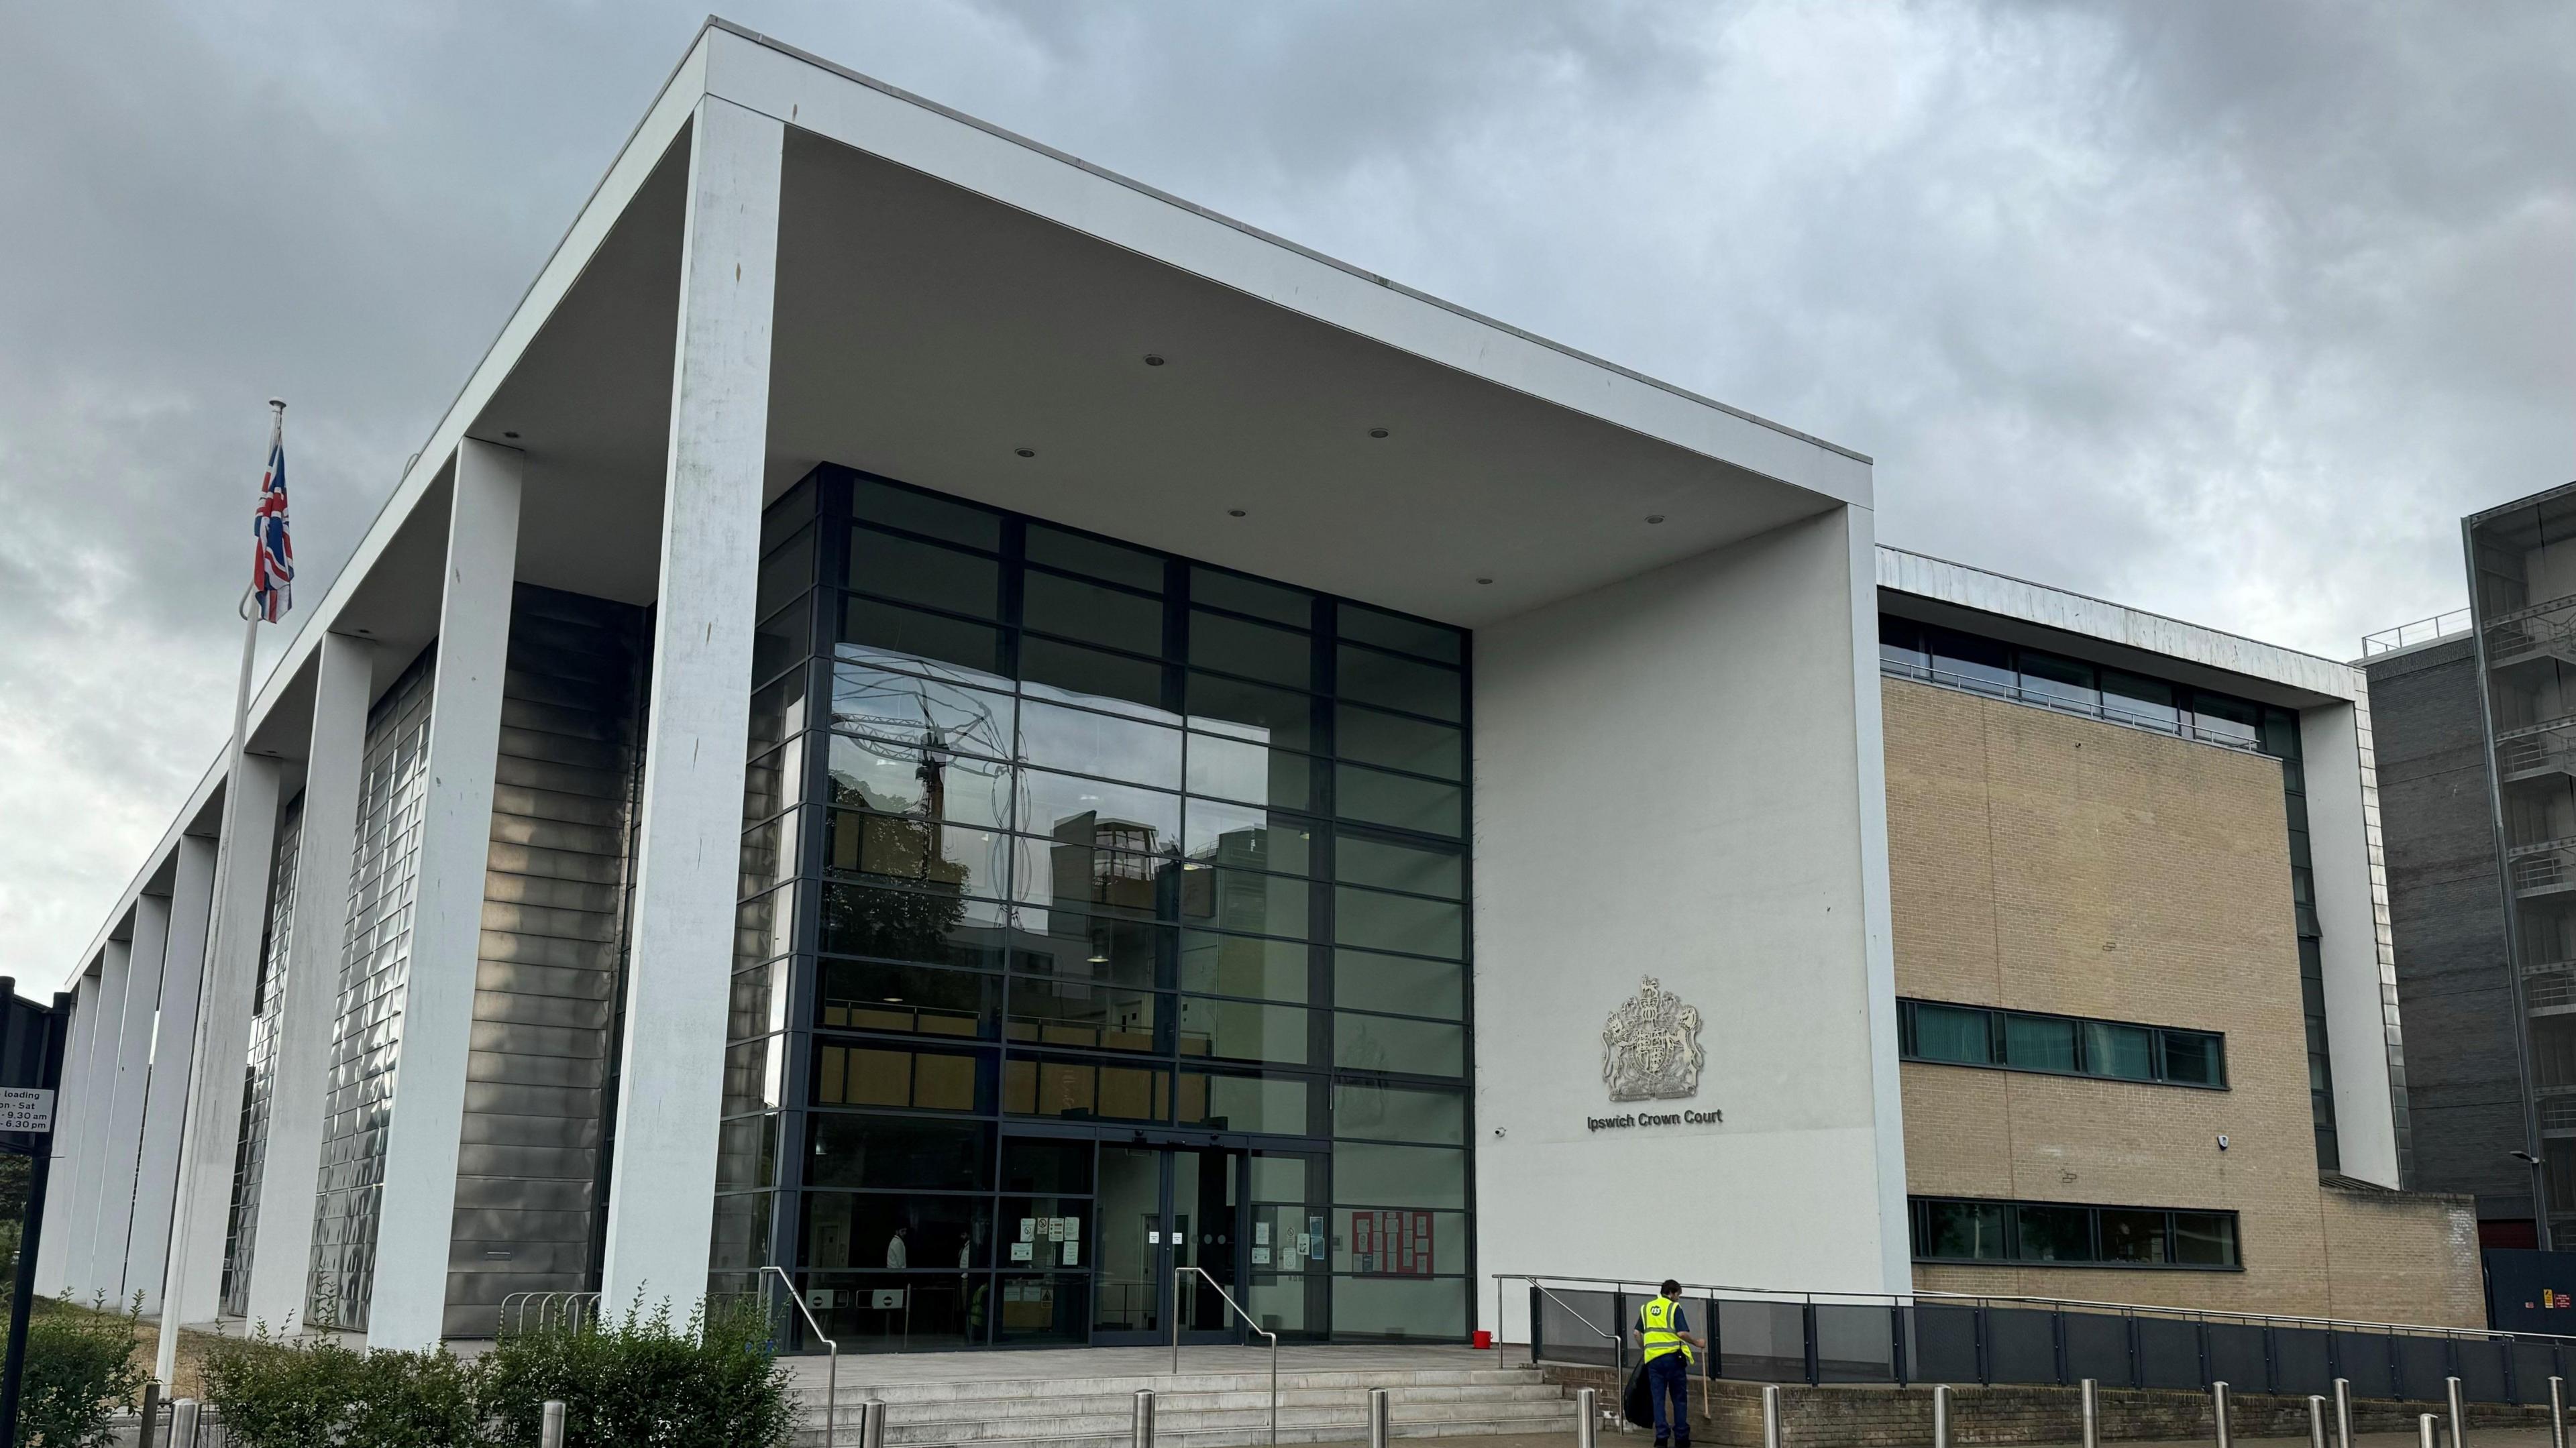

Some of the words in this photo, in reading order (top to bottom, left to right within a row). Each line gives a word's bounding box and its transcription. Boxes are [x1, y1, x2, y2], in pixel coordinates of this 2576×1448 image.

[4, 1090, 40, 1100] loading
[7, 1111, 31, 1119] 9.30
[1587, 1114, 1635, 1131] Ipswich
[1638, 1113, 1681, 1127] Crown
[1684, 1109, 1723, 1124] Court
